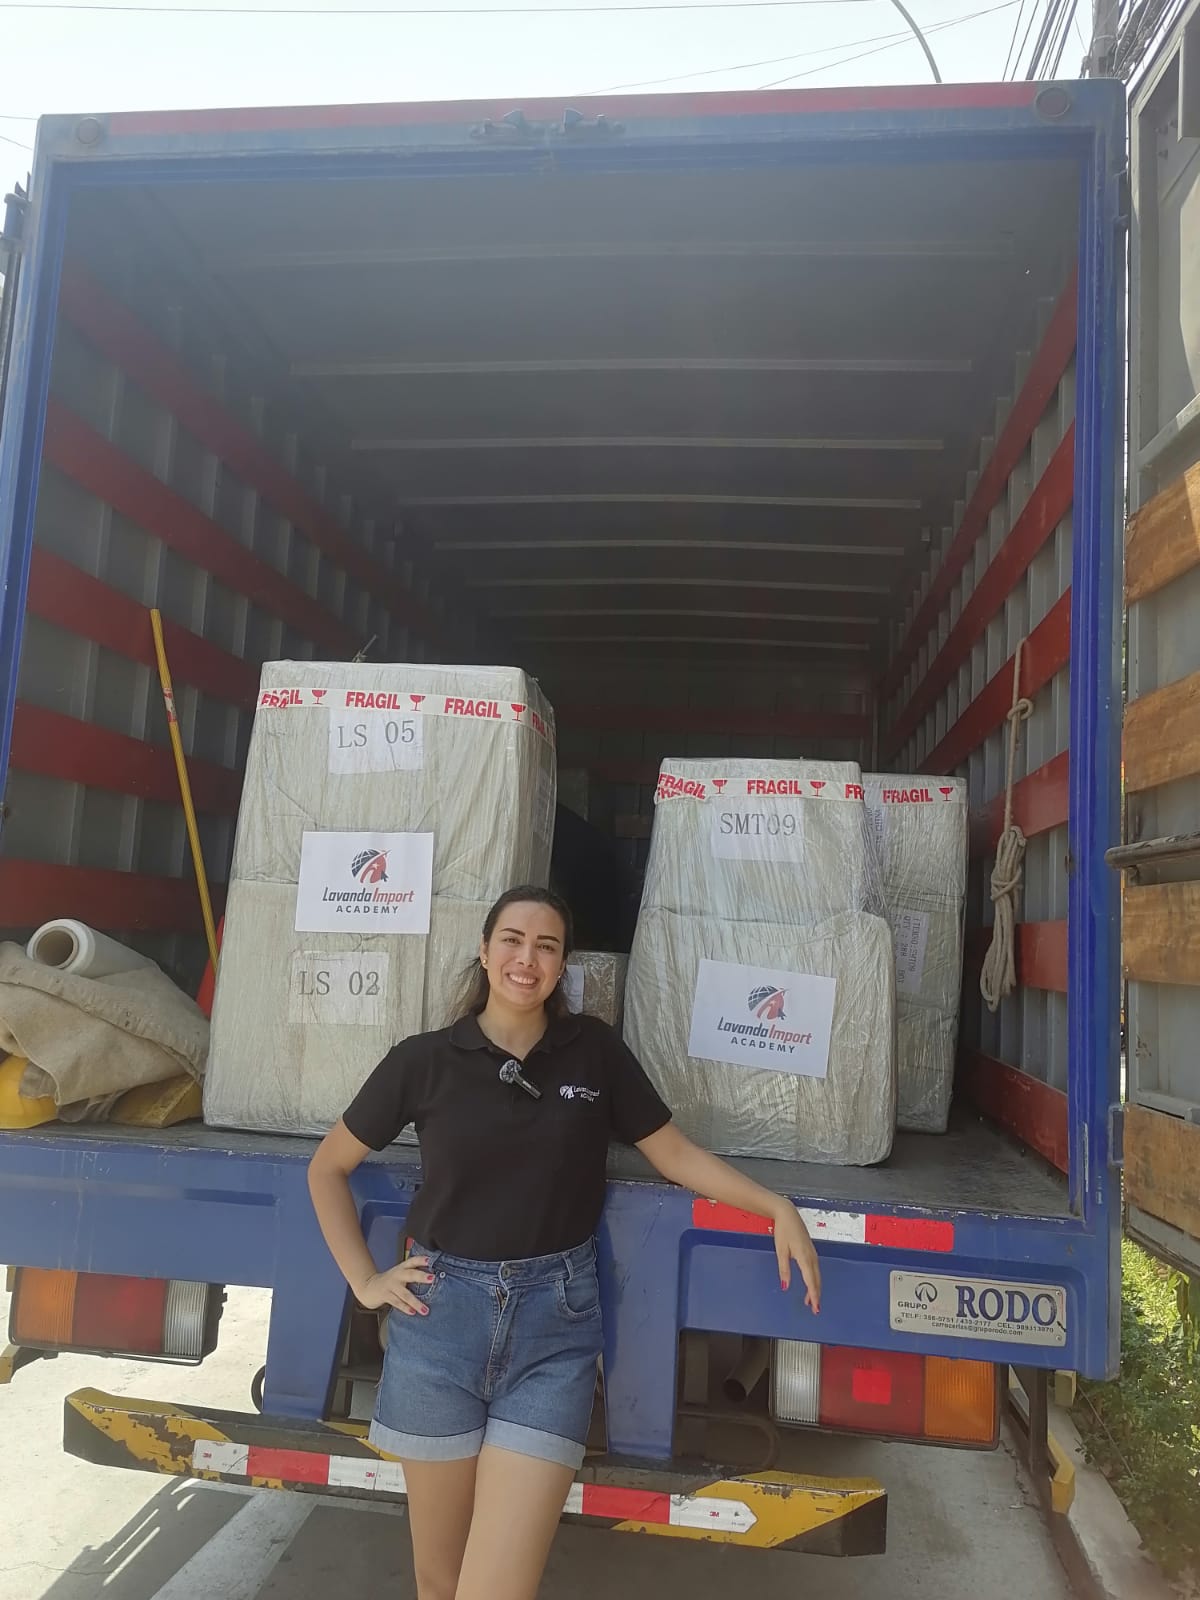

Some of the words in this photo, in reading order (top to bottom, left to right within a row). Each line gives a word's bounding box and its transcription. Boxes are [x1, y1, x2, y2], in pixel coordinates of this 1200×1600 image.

[345, 691, 401, 710] FRAGIL
[444, 698, 502, 719] FRAGIL
[338, 724, 367, 748] LS
[385, 720, 415, 744] 05
[658, 773, 706, 800] FRAGIL
[747, 779, 802, 795] FRAGIL
[845, 784, 865, 801] FR
[882, 788, 934, 804] FRAGIL
[719, 812, 797, 836] SMT09
[336, 905, 400, 914] ACADEMY
[298, 971, 330, 996] LS
[349, 971, 381, 996] 02
[731, 1036, 796, 1053] ACADEMY
[897, 1301, 928, 1310] GRUPO
[955, 1285, 1058, 1326] RODO
